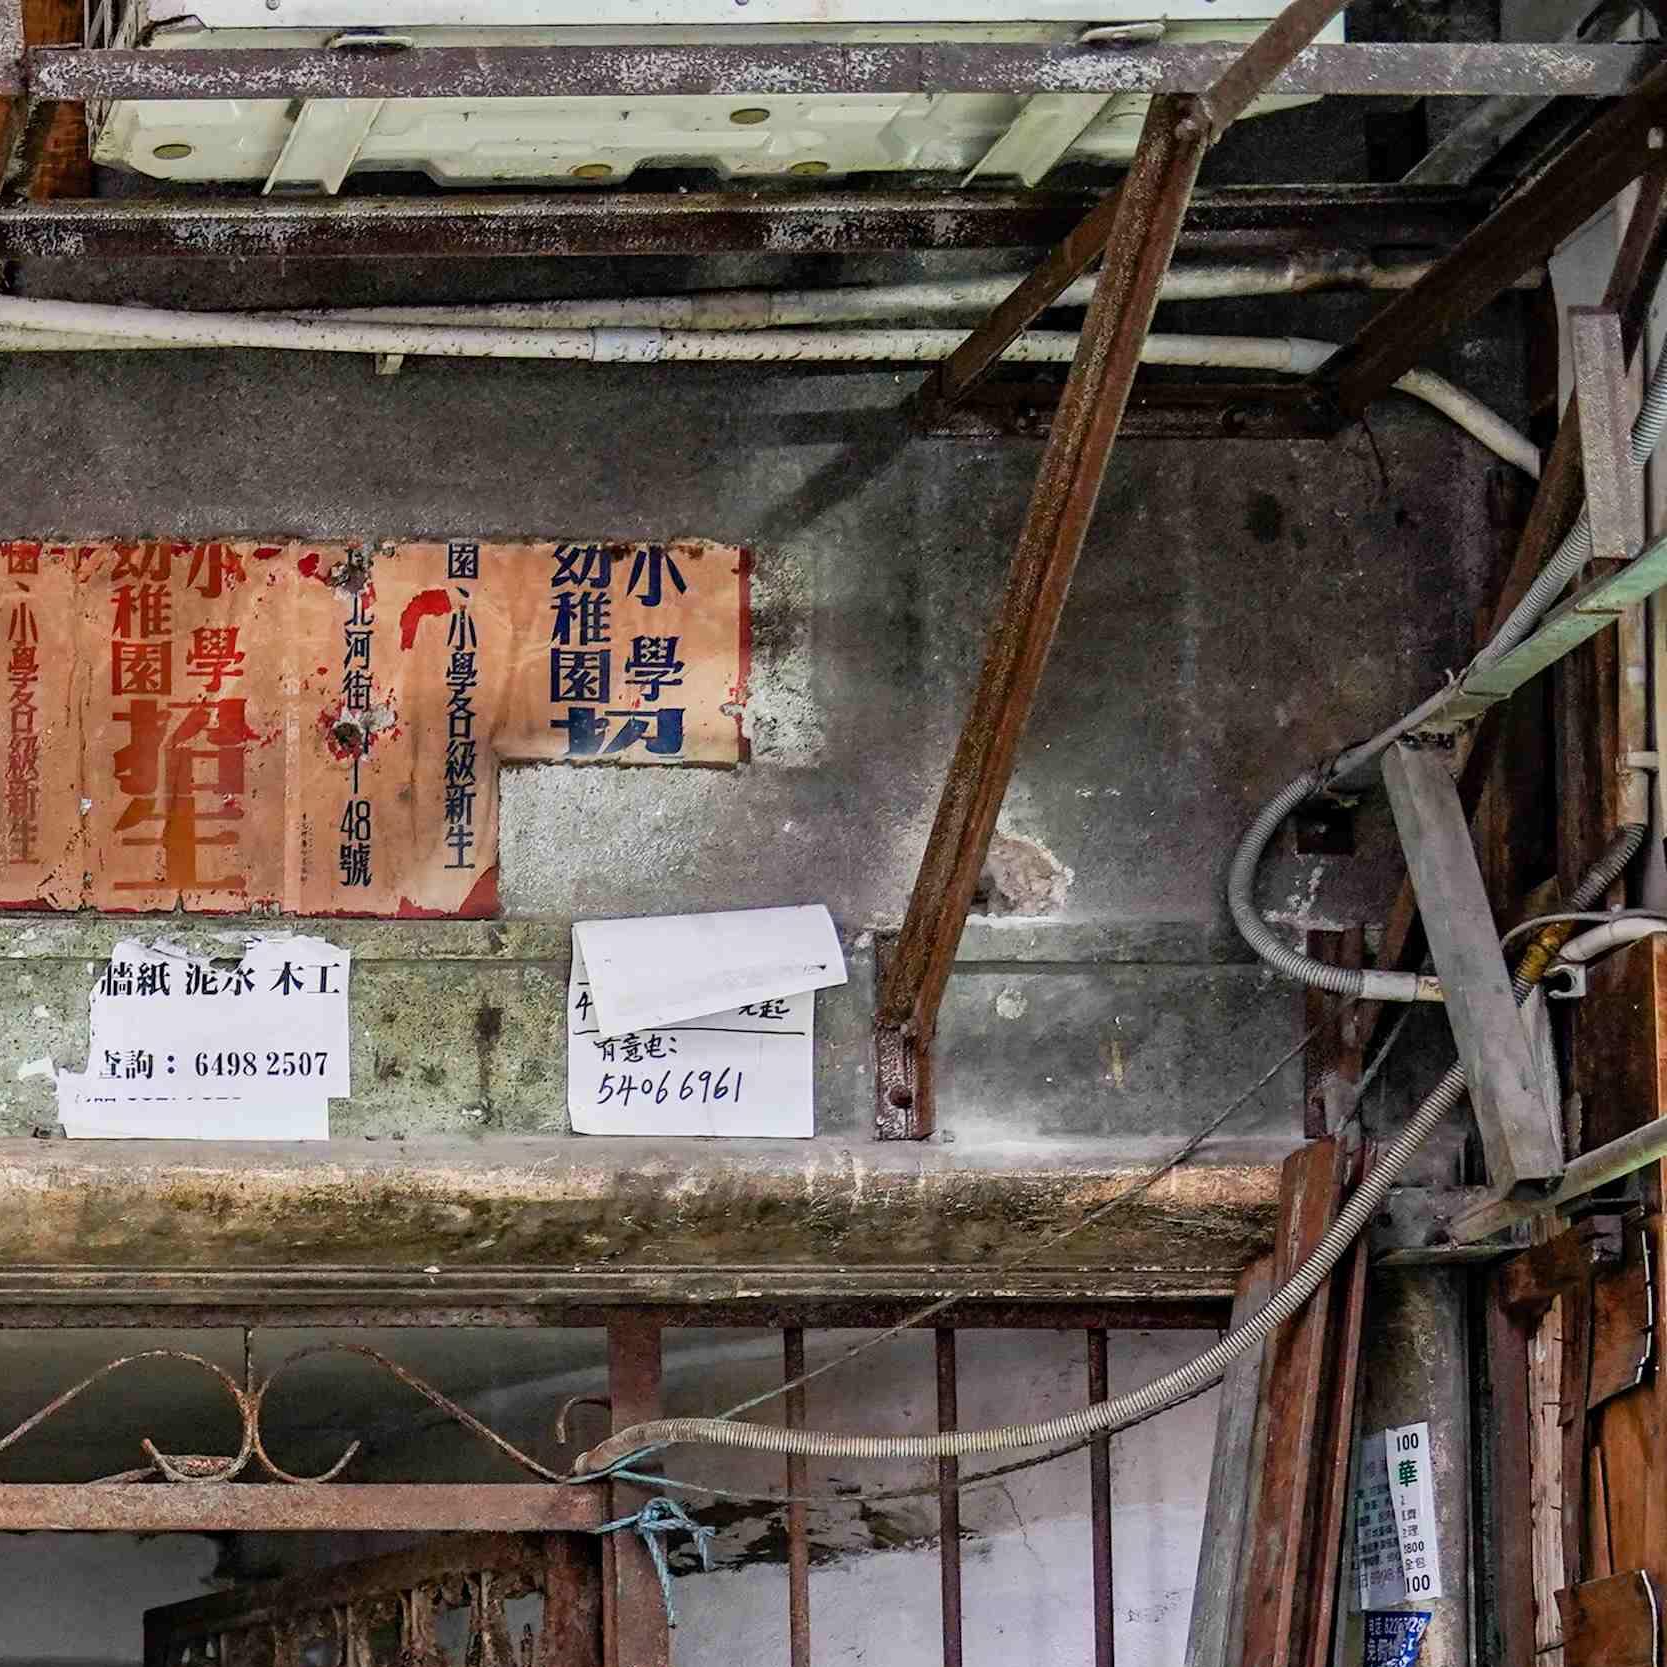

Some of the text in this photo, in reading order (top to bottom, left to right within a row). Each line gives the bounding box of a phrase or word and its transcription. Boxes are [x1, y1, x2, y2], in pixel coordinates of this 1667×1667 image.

[269, 961, 341, 996] 木工
[195, 1050, 258, 1078] 6498
[266, 1050, 329, 1078] 2507
[1398, 1459, 1418, 1488] 華
